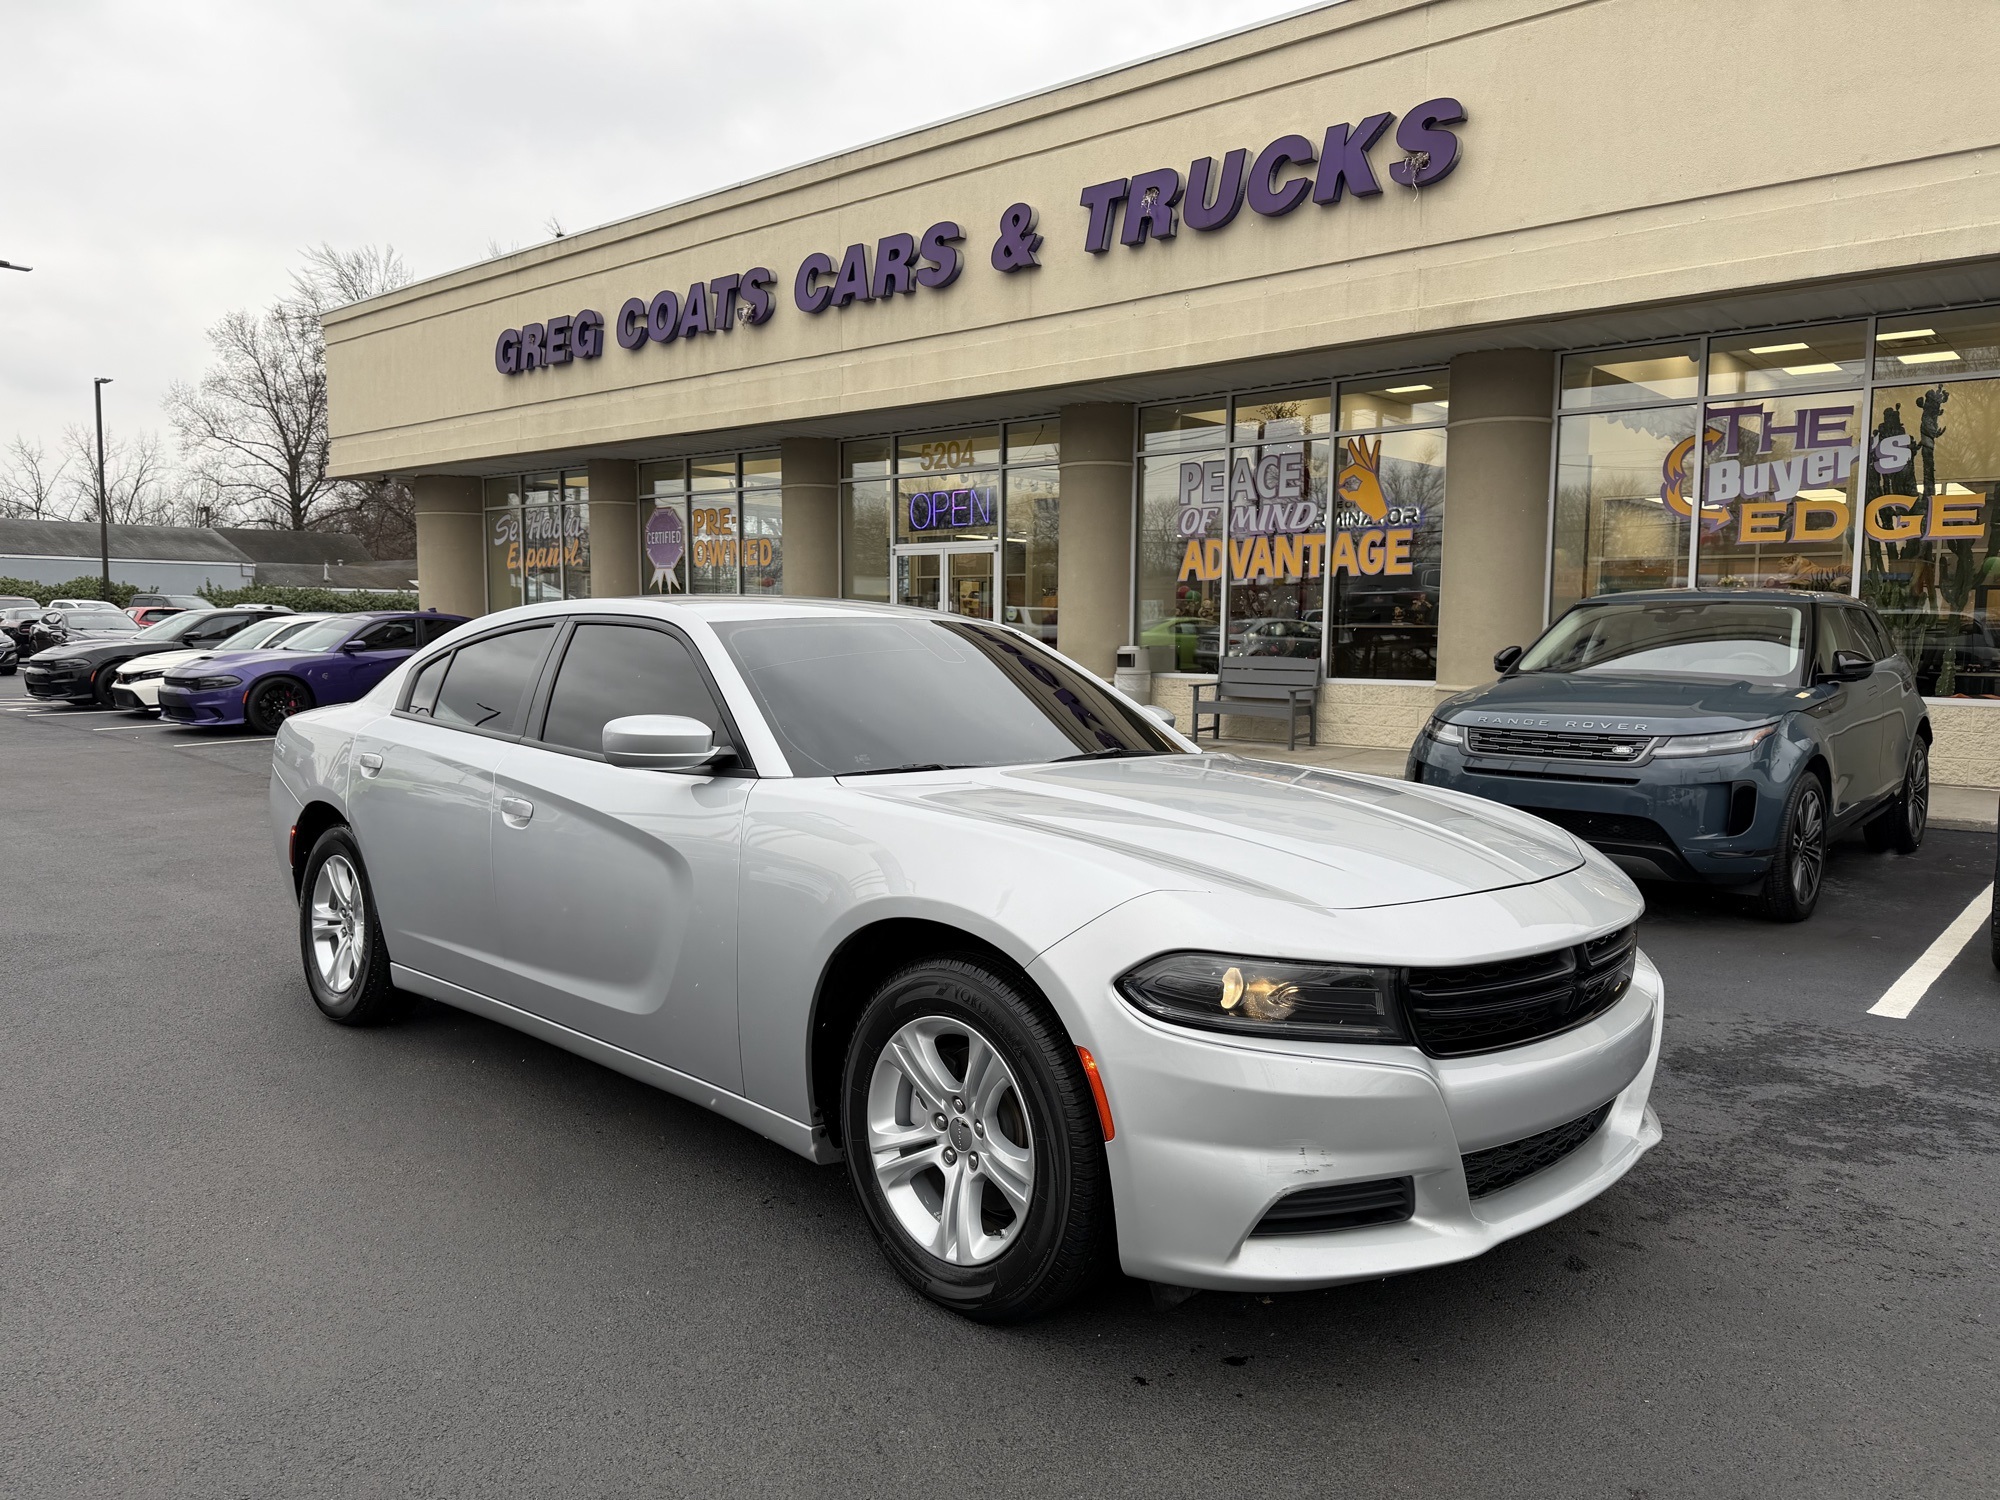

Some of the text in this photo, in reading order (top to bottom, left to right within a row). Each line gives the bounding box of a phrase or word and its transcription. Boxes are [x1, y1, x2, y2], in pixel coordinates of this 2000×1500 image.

[495, 97, 1468, 376] GREG COATS CARS & TRUCKS
[1706, 404, 1854, 456] THE
[919, 439, 976, 471] 5204
[1707, 433, 1911, 504] Buyer's
[1179, 452, 1302, 504] PEACE
[494, 506, 584, 546] Se Habla
[692, 507, 737, 537] PRE-
[909, 487, 991, 530] OPEN
[1179, 502, 1318, 535] OF MIND
[1735, 493, 1986, 544] EDGE
[506, 538, 584, 576] Español
[646, 530, 682, 545] CERTIFIED
[693, 538, 773, 568] OWNED
[1177, 529, 1414, 582] ADVANTAGE
[1478, 716, 1649, 731] RANGE ROVER
